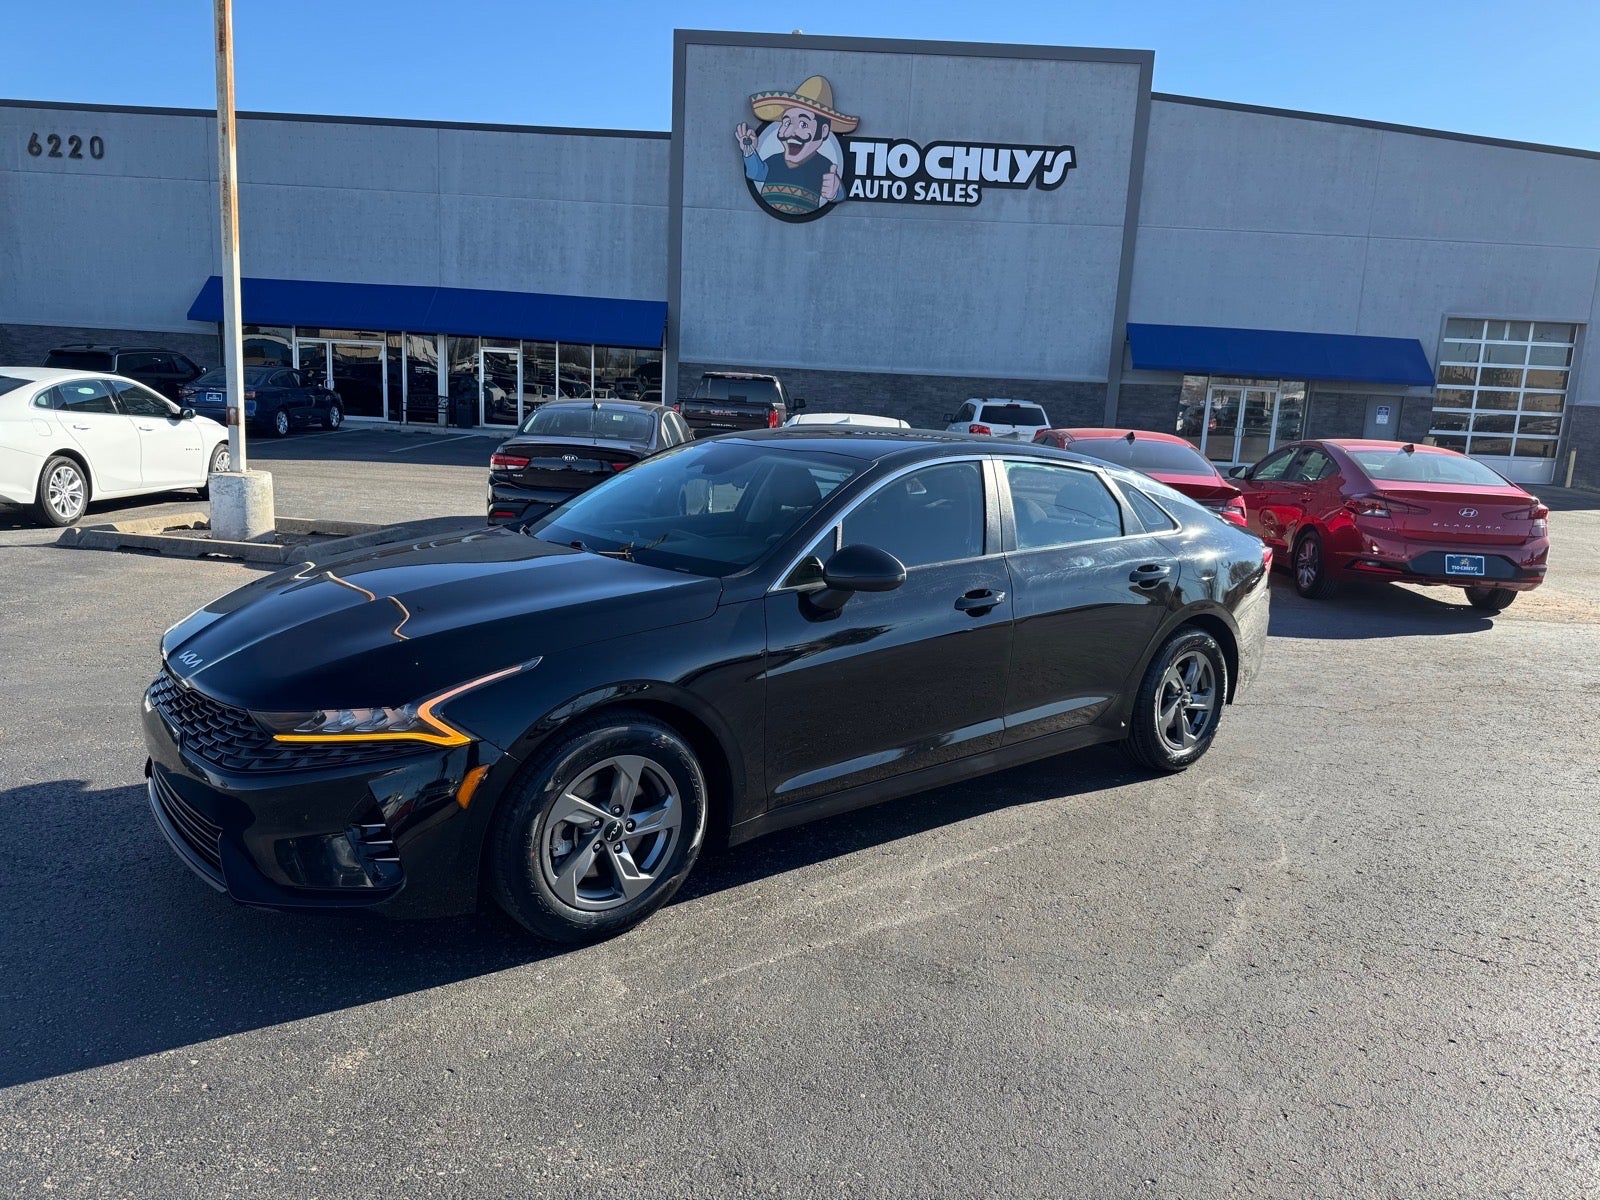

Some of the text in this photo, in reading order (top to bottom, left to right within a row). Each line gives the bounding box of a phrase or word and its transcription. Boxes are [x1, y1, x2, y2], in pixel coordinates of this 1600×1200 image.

[28, 132, 105, 159] 6220
[849, 141, 1073, 185] TIO CHUY'S
[849, 178, 979, 204] AUTO SALES
